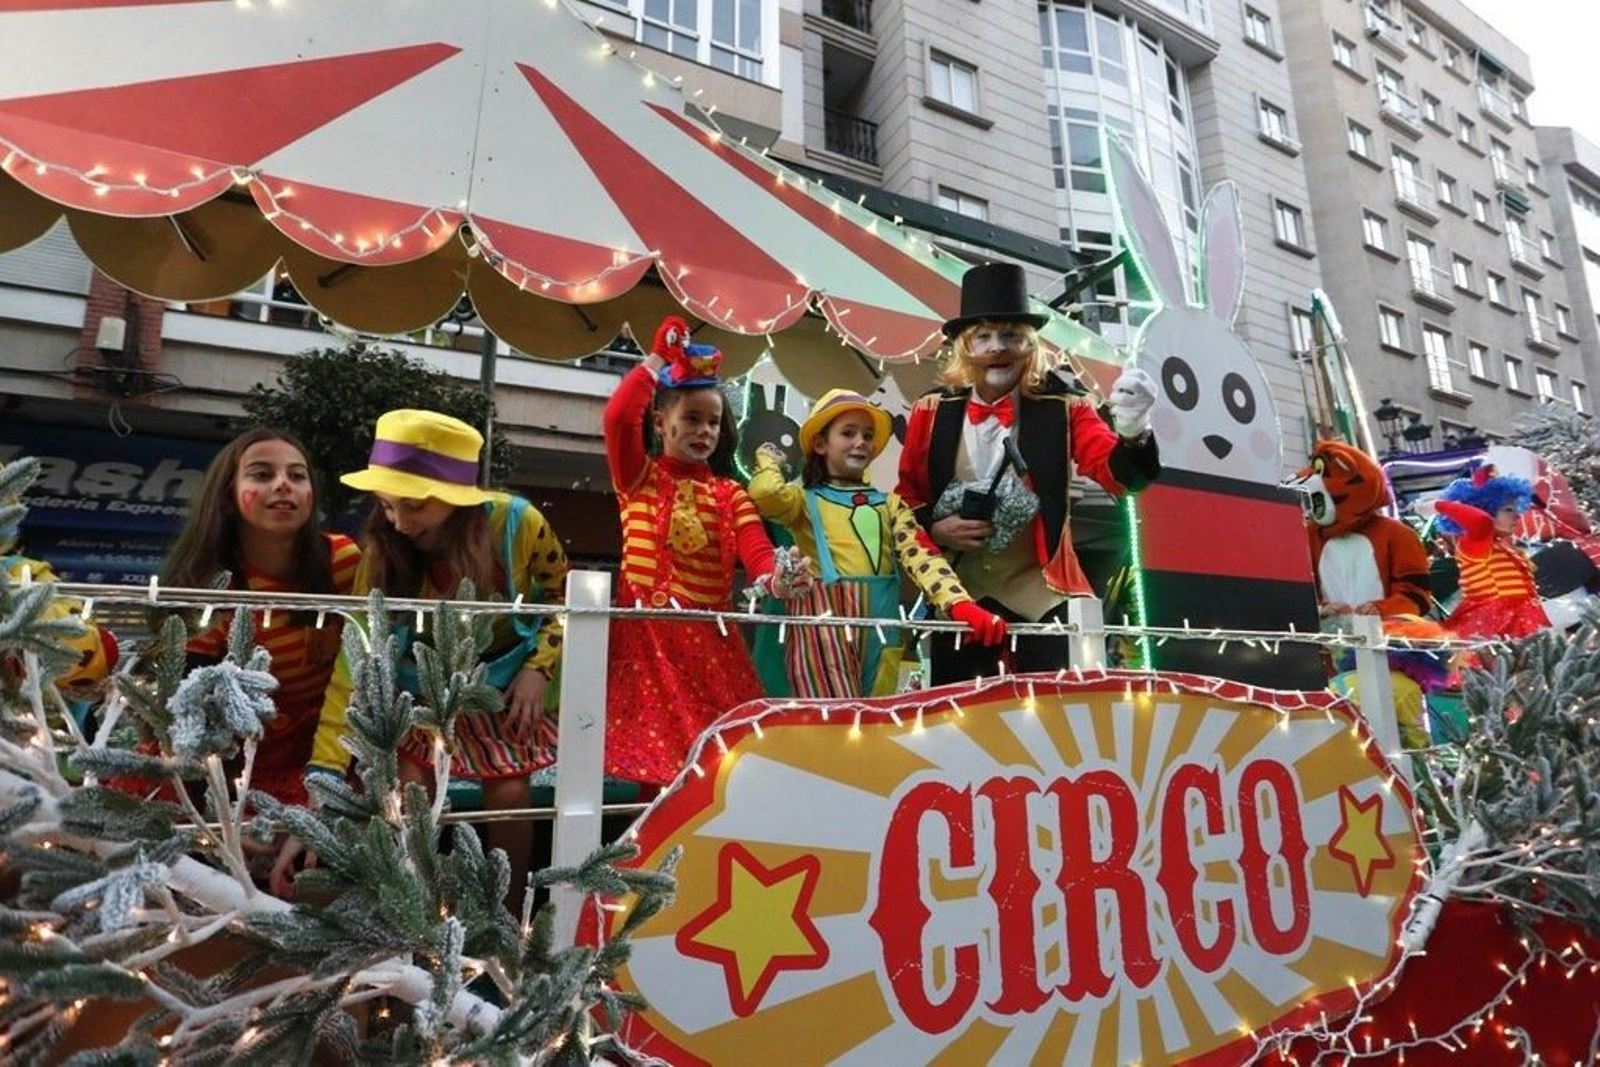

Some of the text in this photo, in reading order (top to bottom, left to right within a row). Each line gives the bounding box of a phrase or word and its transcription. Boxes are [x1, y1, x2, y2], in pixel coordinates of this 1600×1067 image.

[0, 445, 204, 501] ash
[106, 500, 190, 518] Expres
[868, 758, 1310, 1035] CIRCO
